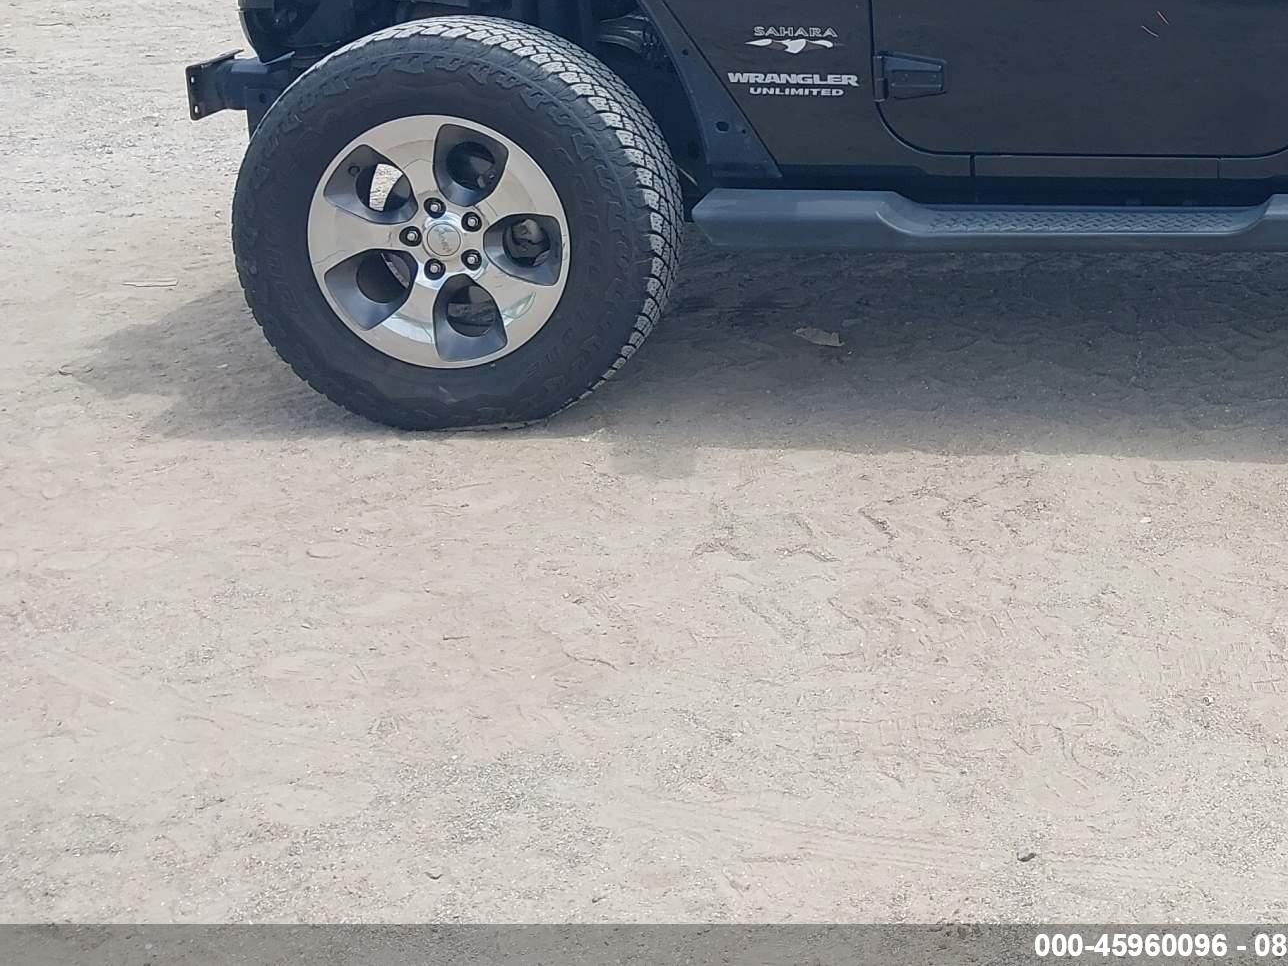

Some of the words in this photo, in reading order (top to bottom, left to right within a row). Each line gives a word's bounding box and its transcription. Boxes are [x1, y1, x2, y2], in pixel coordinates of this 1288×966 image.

[753, 26, 839, 38] SAHARA
[727, 72, 860, 87] WRANGLER
[749, 87, 844, 97] UNLIMITED
